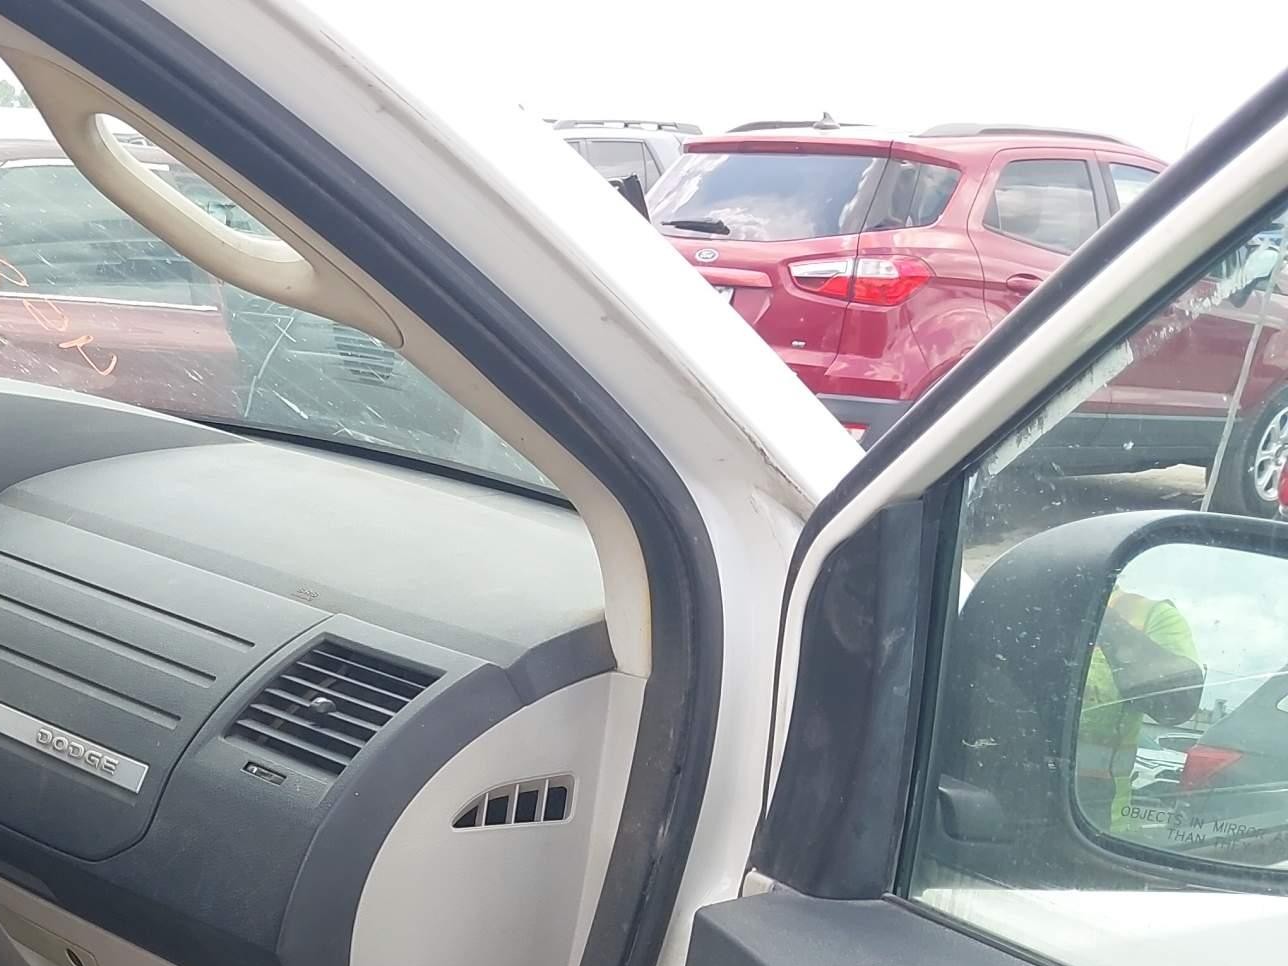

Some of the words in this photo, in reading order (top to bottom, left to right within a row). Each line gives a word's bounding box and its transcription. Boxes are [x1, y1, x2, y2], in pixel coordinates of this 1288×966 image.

[37, 728, 119, 775] DODGE
[1120, 806, 1183, 827] OBJECTS
[1189, 815, 1205, 830] IN
[1167, 828, 1207, 844] THAN
